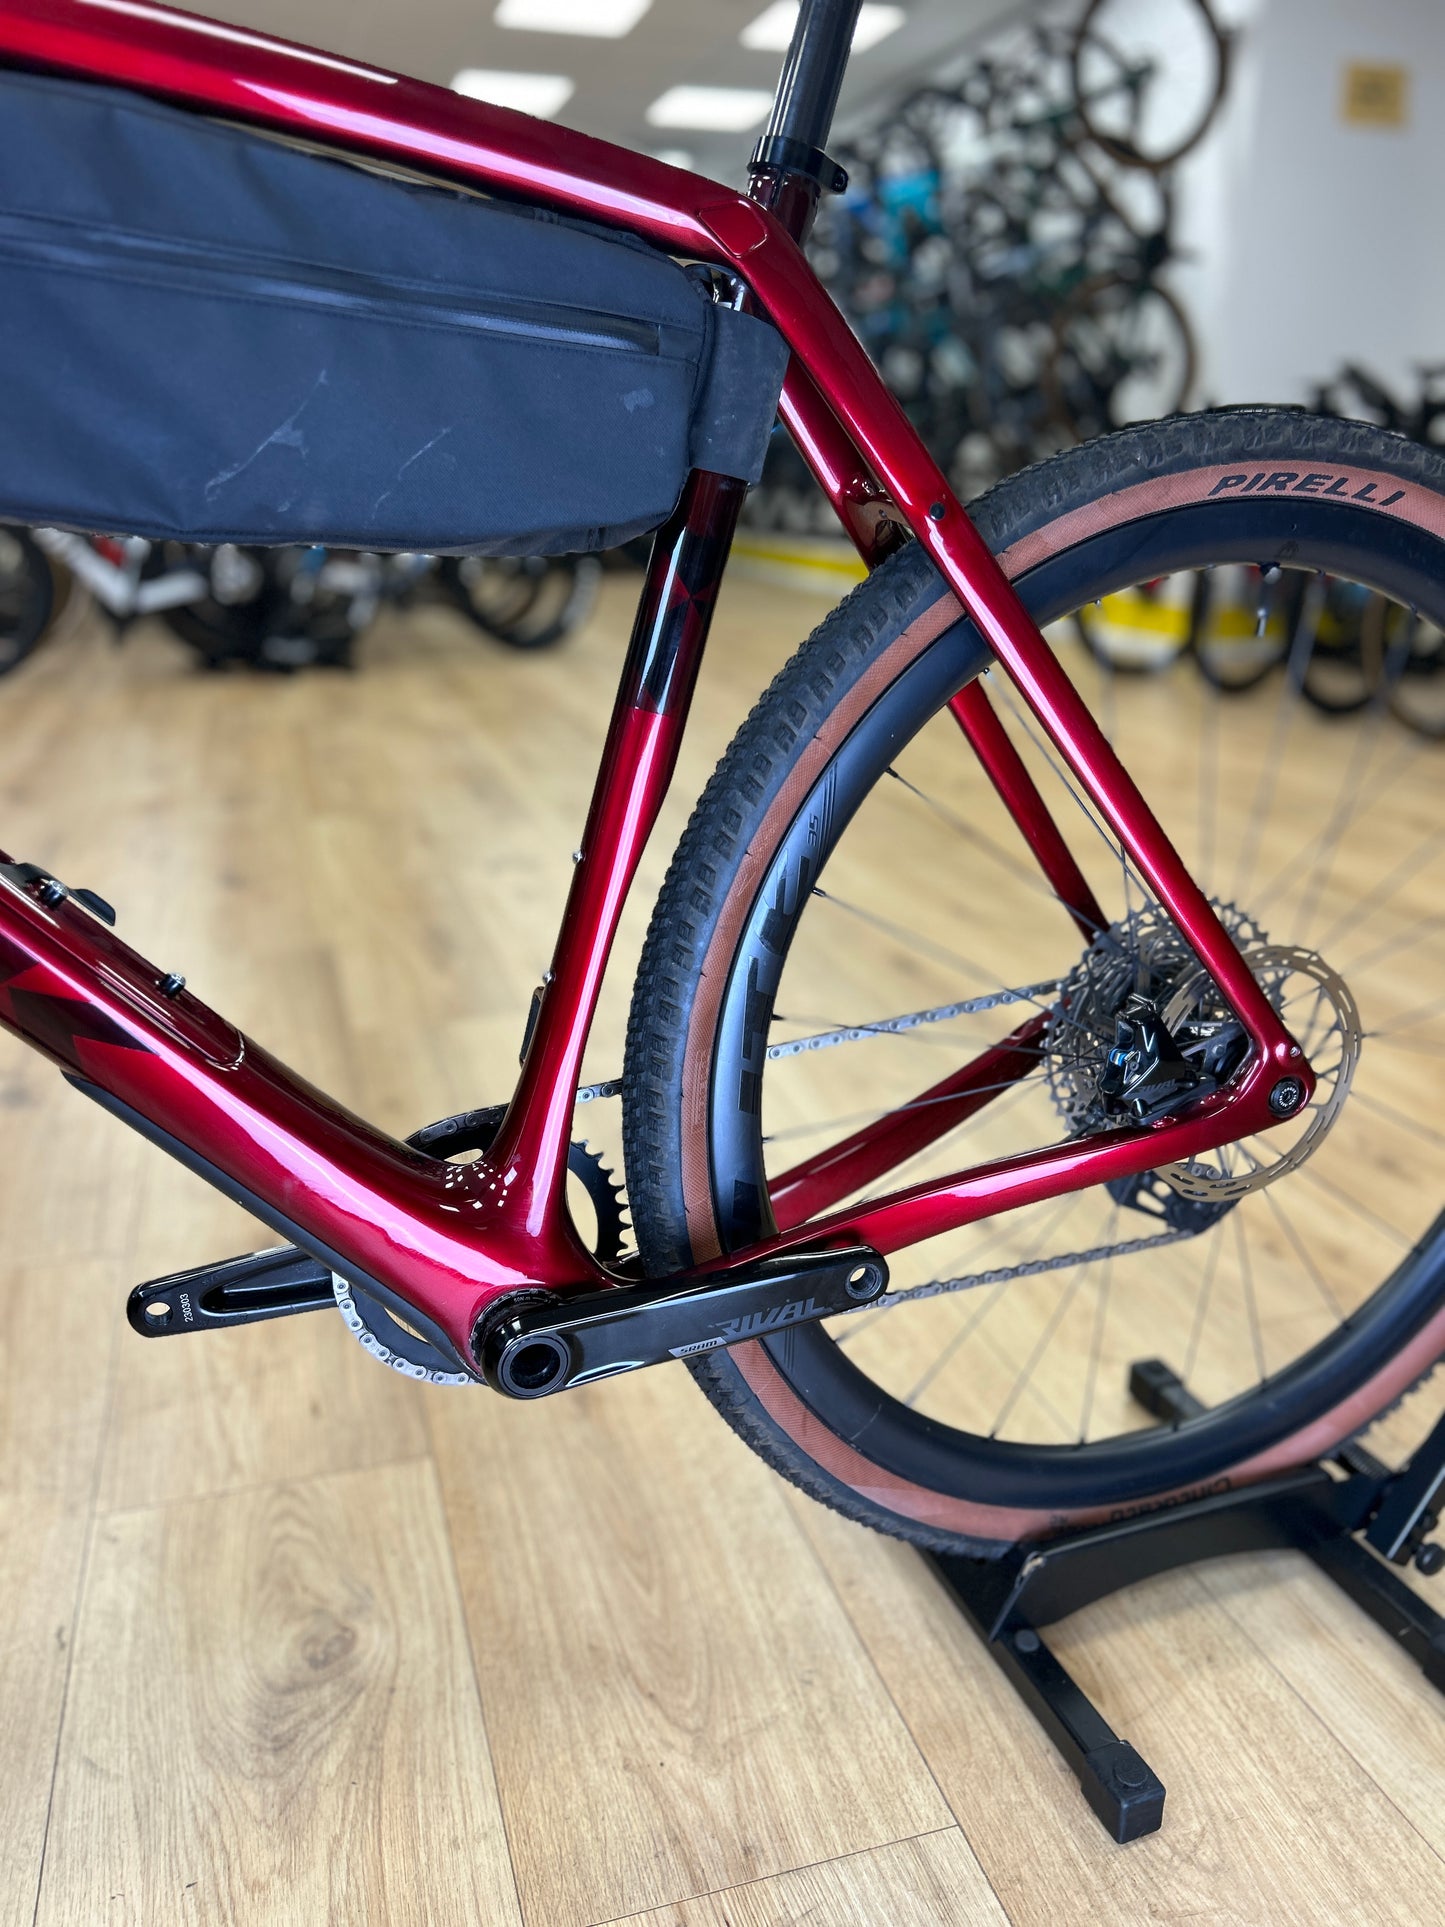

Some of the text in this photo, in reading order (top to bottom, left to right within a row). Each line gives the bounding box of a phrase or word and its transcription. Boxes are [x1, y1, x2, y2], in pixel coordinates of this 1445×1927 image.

[1207, 472, 1406, 507] PIRELLI
[807, 812, 819, 848] 35
[179, 1293, 194, 1323] 230303
[714, 1297, 827, 1338] RIVAL
[680, 1339, 718, 1354] SRAM
